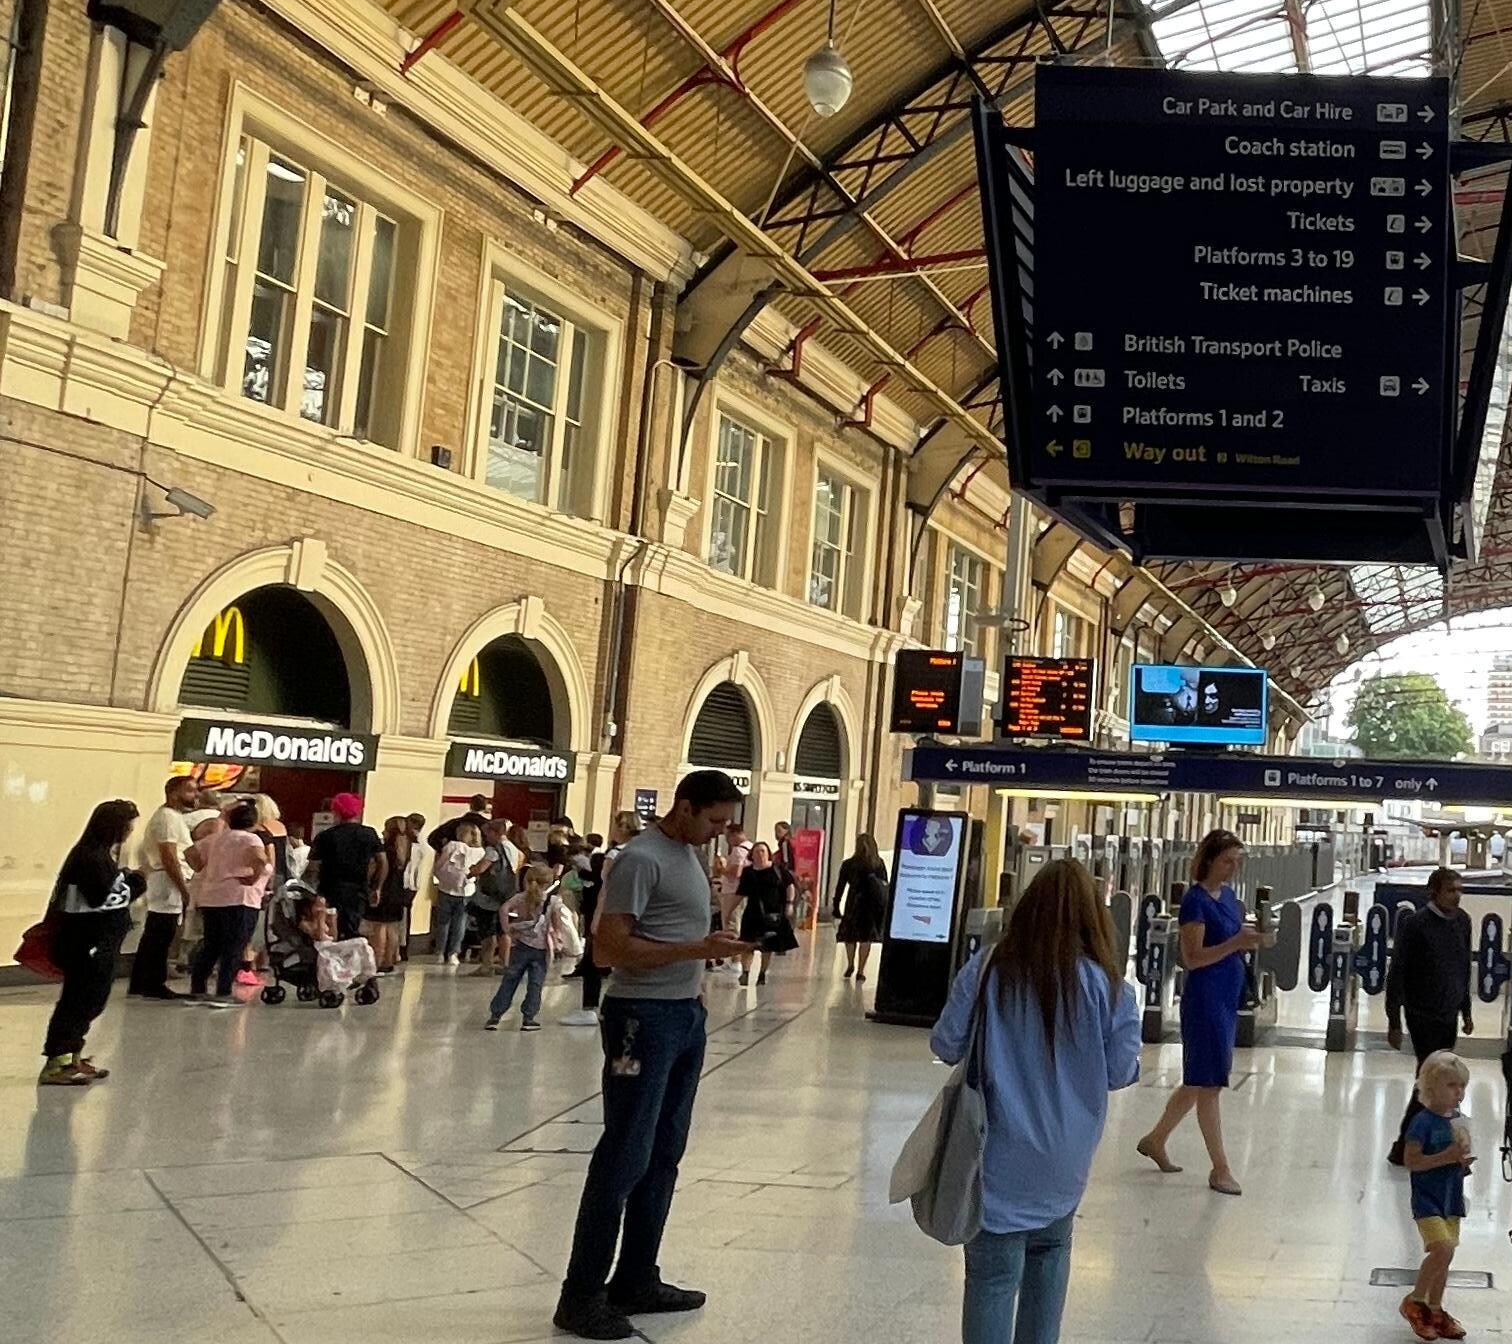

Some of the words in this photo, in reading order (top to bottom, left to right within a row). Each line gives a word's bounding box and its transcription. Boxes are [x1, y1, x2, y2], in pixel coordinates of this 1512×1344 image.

[1162, 97, 1193, 114] Car
[1198, 98, 1237, 116] Park
[1242, 100, 1275, 118] and
[1280, 101, 1310, 118] Car
[1316, 103, 1353, 120] Hire
[1225, 136, 1284, 155] Coach
[1289, 140, 1355, 158] station
[1065, 168, 1104, 187] Left
[1109, 170, 1184, 193] luggage
[1189, 173, 1224, 191] and
[1230, 173, 1265, 192] lost
[1271, 177, 1354, 198] property
[1286, 211, 1355, 231] Tickets
[1194, 245, 1286, 266] Platforms
[1291, 248, 1303, 266] 3
[1308, 250, 1328, 267] to
[1333, 249, 1354, 268] 19
[1200, 281, 1258, 301] Ticket
[1263, 284, 1353, 304] machines
[1124, 334, 1185, 353] British
[1191, 336, 1282, 359] Transport
[1287, 339, 1343, 358] Police
[1123, 370, 1186, 390] Toilets
[1299, 375, 1347, 393] Taxis
[1122, 407, 1214, 426] Platforms
[1218, 409, 1227, 426] 1
[1232, 410, 1267, 428] and
[1272, 410, 1284, 428] 2
[1123, 441, 1167, 464] Way
[1172, 445, 1207, 462] out
[1236, 453, 1272, 464] Wilton
[205, 726, 364, 765] McDonald's
[464, 750, 568, 779] McDonald's
[962, 760, 1016, 775] Platform
[1019, 762, 1026, 774] 1
[1287, 772, 1348, 787] Platforms
[1350, 774, 1356, 787] 1
[1359, 776, 1372, 788] to
[1376, 775, 1385, 788] 7
[1395, 778, 1422, 793] only
